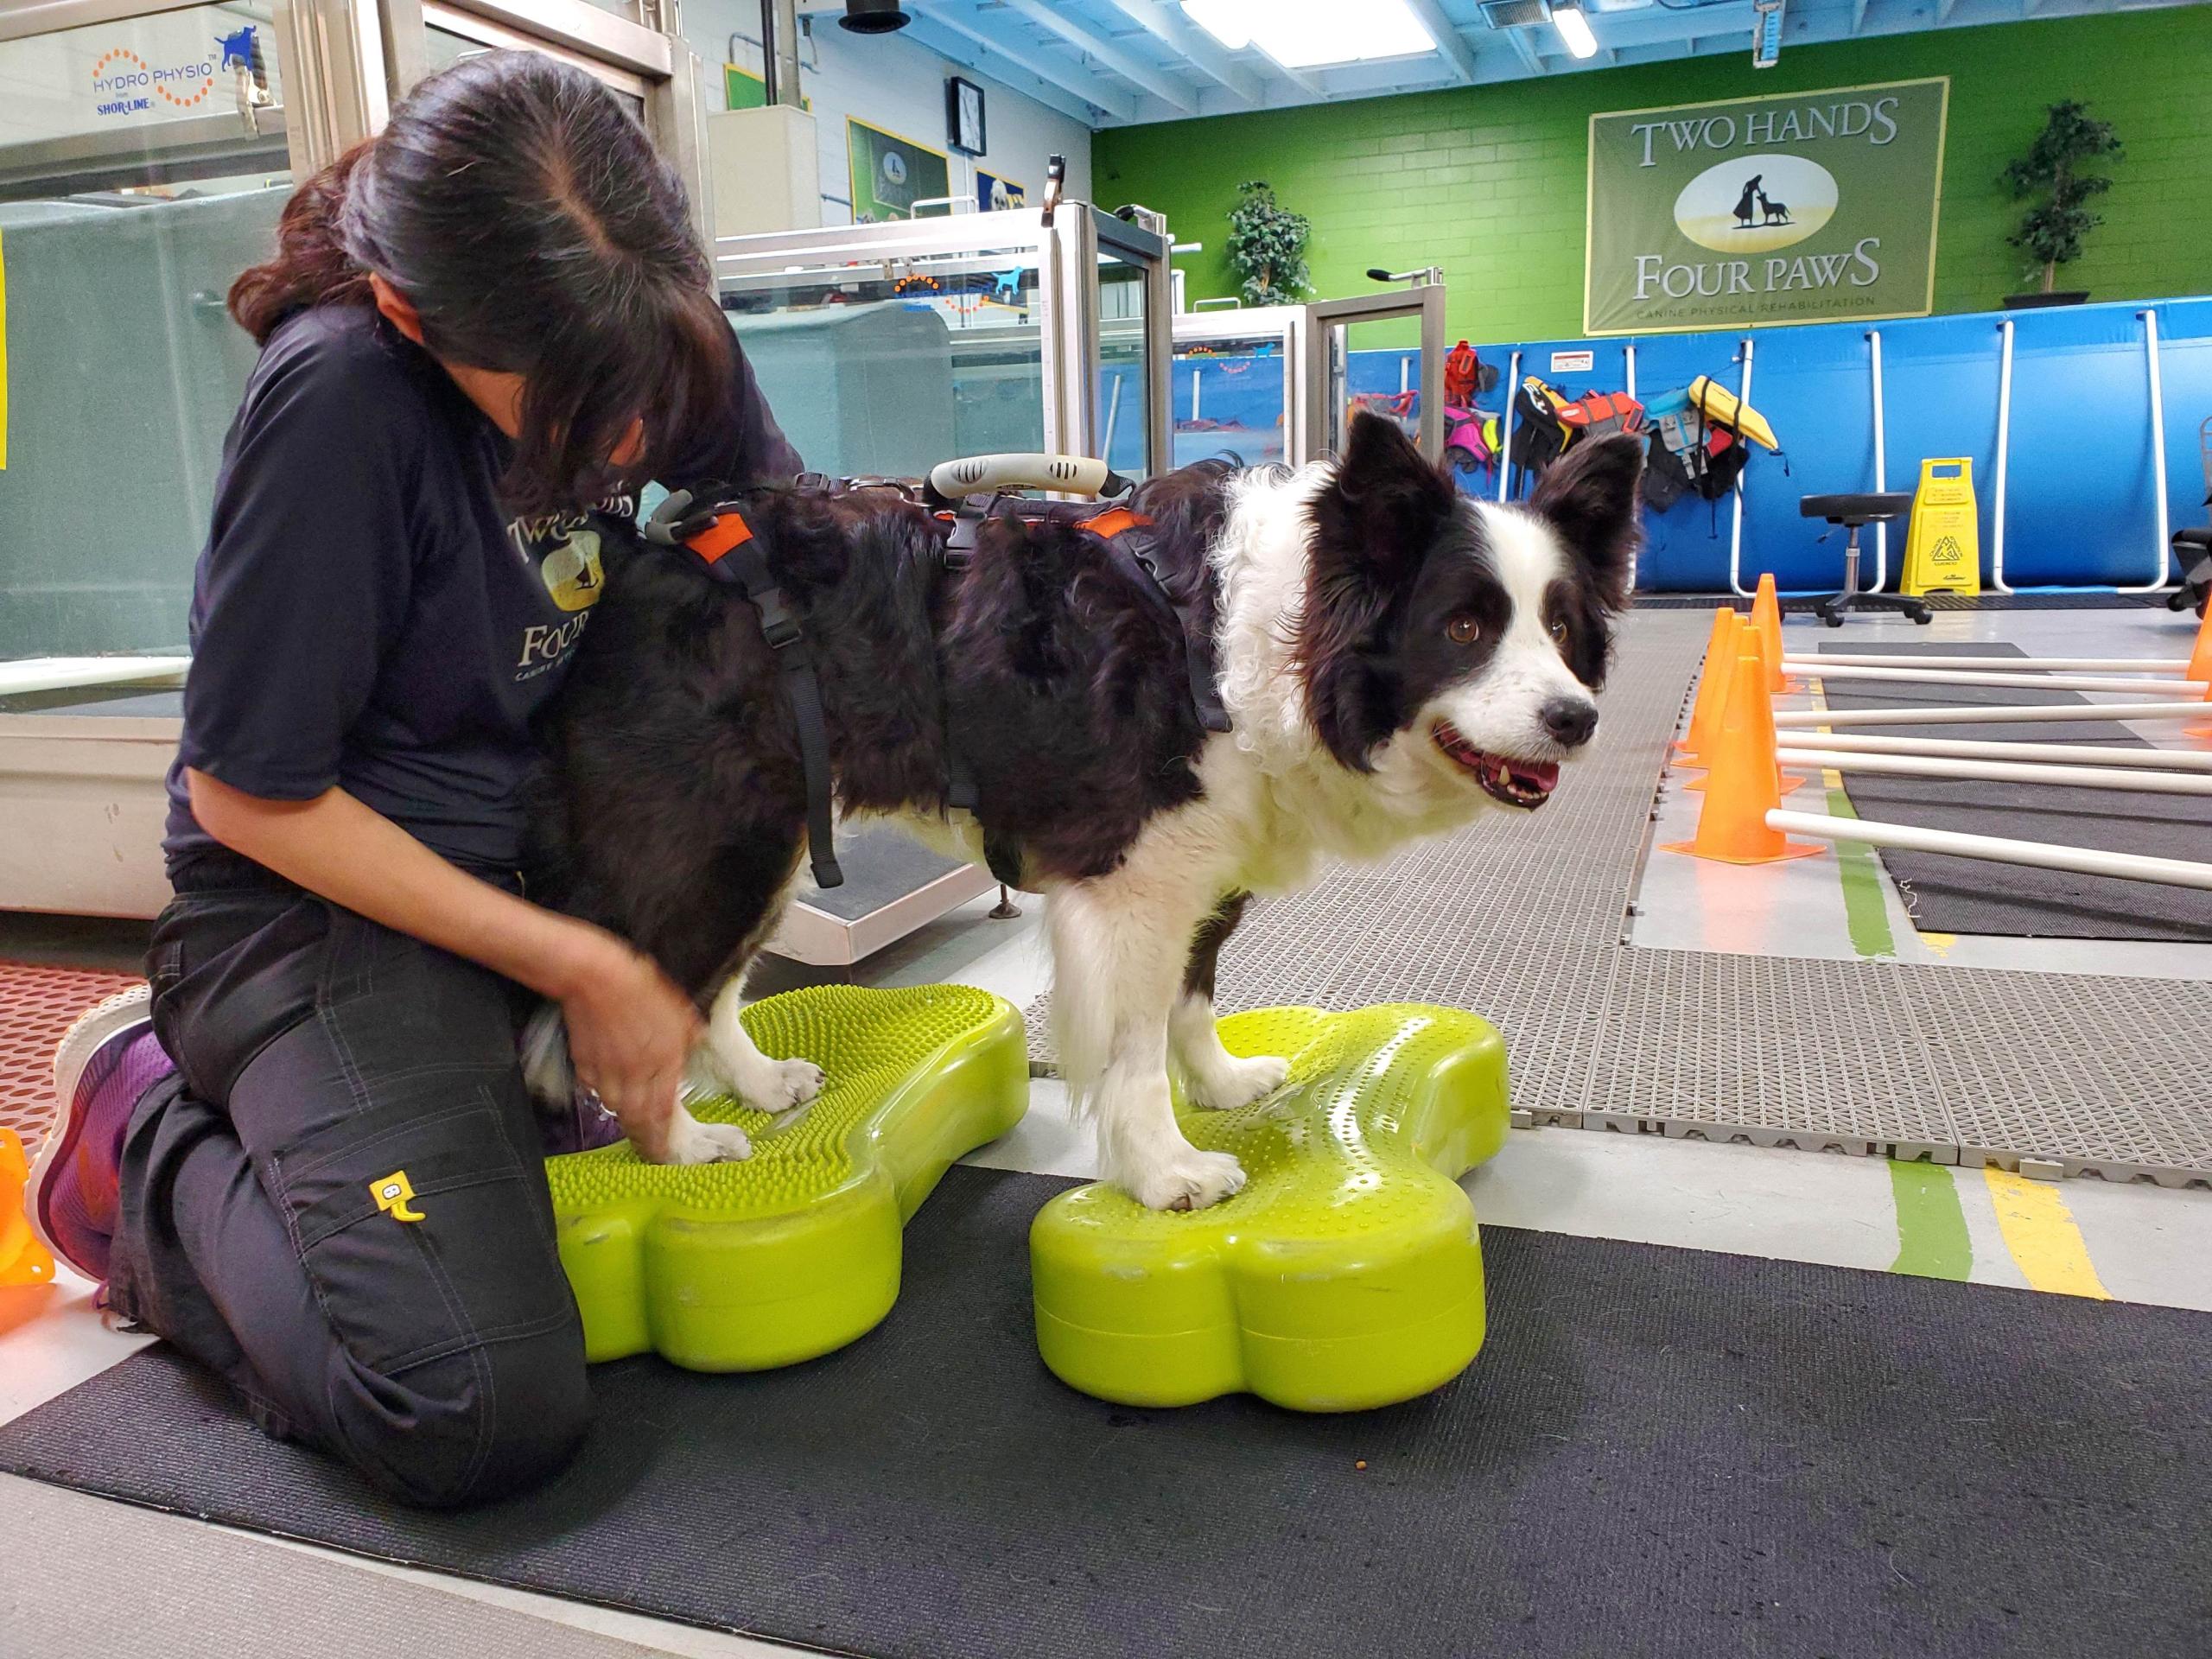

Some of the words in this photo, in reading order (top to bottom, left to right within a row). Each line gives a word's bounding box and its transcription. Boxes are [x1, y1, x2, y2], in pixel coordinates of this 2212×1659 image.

[93, 73, 149, 92] HYDRO
[153, 63, 213, 83] PHYSIO
[1630, 115, 1735, 167] TWO
[1744, 97, 1898, 146] HANDS
[1632, 255, 1756, 301] FOUR
[1764, 237, 1880, 293] PAWS
[1637, 308, 1685, 320] CANINE
[1690, 304, 1755, 316] PHYSICAL
[1760, 296, 1875, 313] REHABILITATION
[518, 610, 589, 667] FOUR
